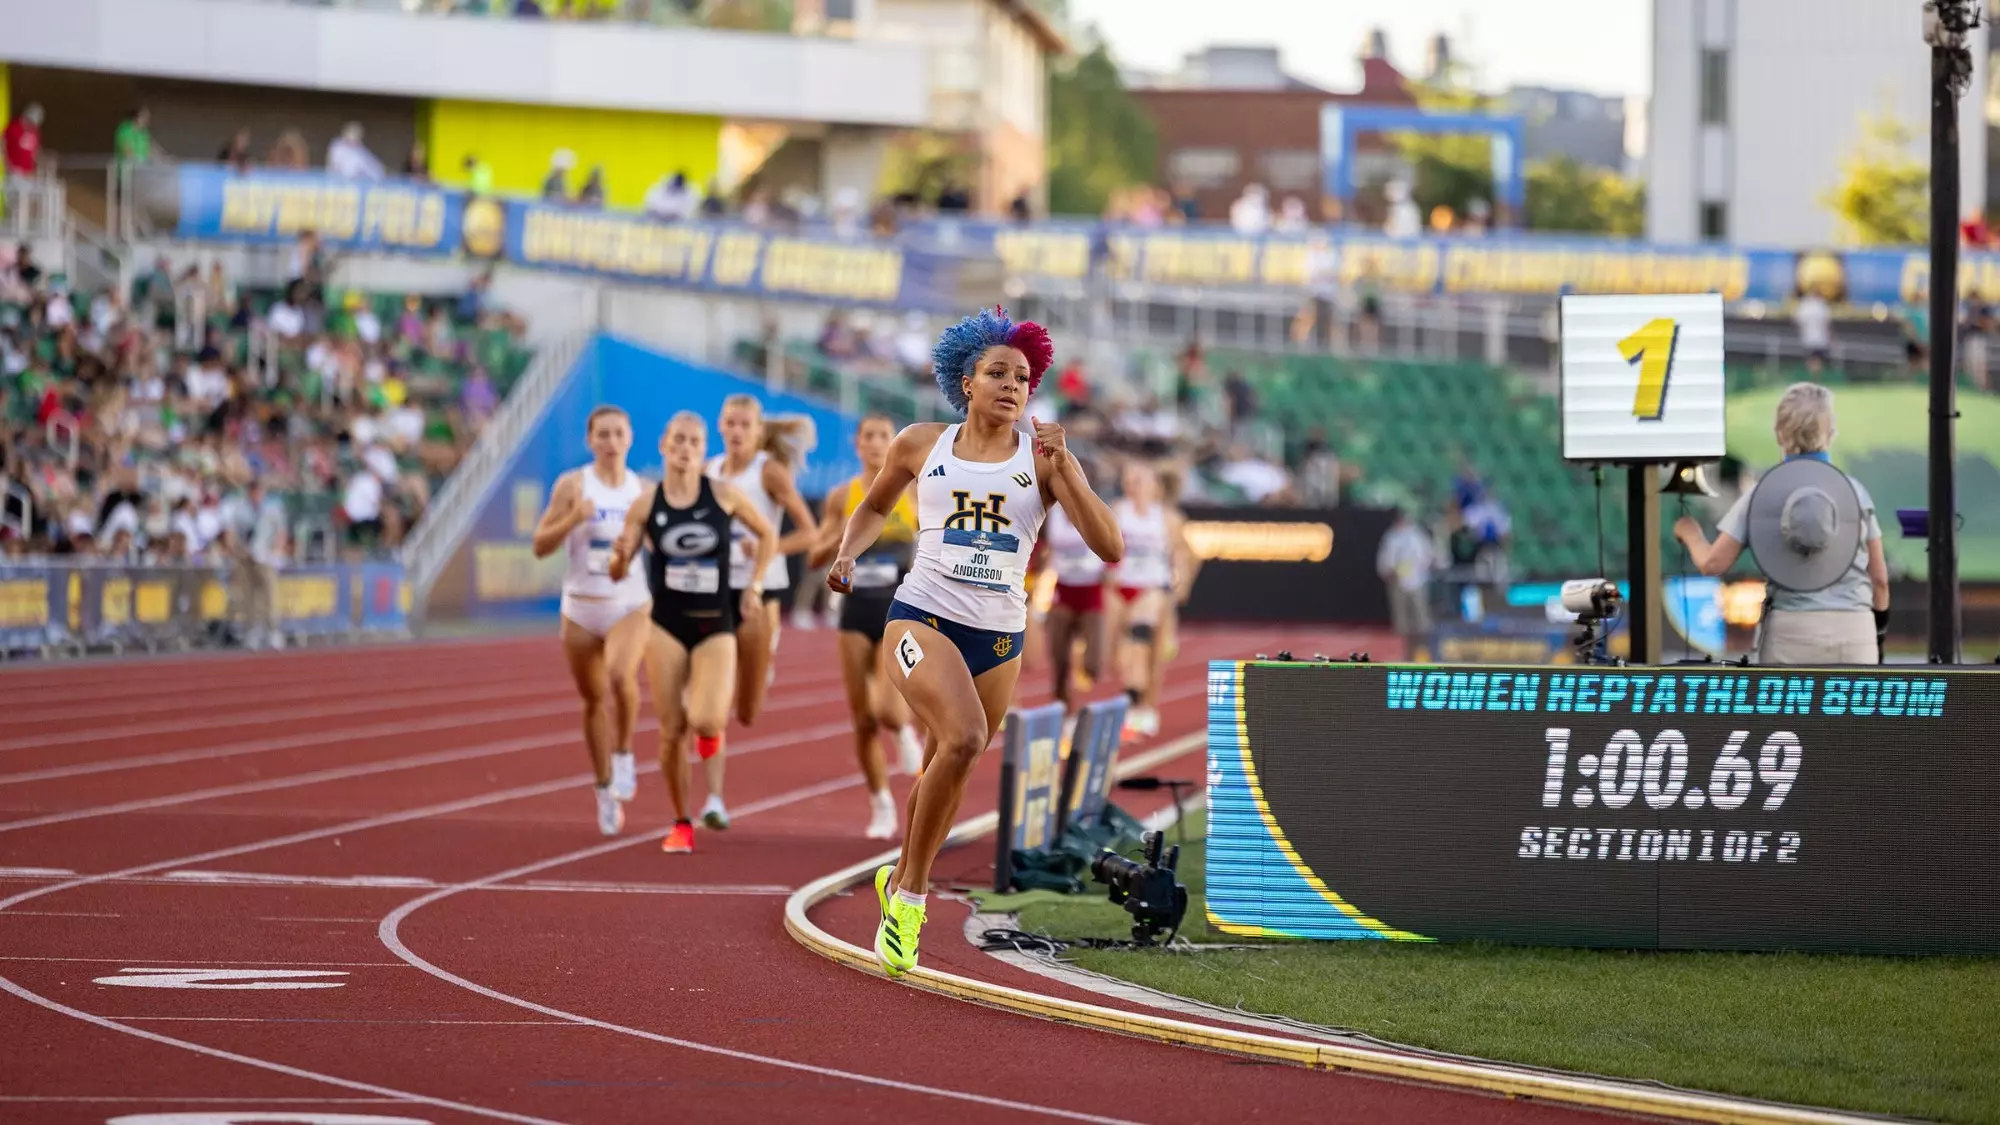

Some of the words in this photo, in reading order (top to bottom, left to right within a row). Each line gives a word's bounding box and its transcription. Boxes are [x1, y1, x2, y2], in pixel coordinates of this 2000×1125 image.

[1616, 317, 1680, 422] 1
[952, 564, 1002, 581] ANDERSON
[971, 553, 990, 565] JOY
[1386, 671, 1540, 711] WOMEN
[1546, 673, 1813, 715] HEPTATHLON
[1822, 676, 1947, 717] 800M
[1542, 728, 1803, 811] 1:00.69
[1518, 826, 1692, 861] SECTION
[1697, 829, 1714, 861] 1
[1722, 830, 1772, 862] OF
[1777, 831, 1801, 863] 2
